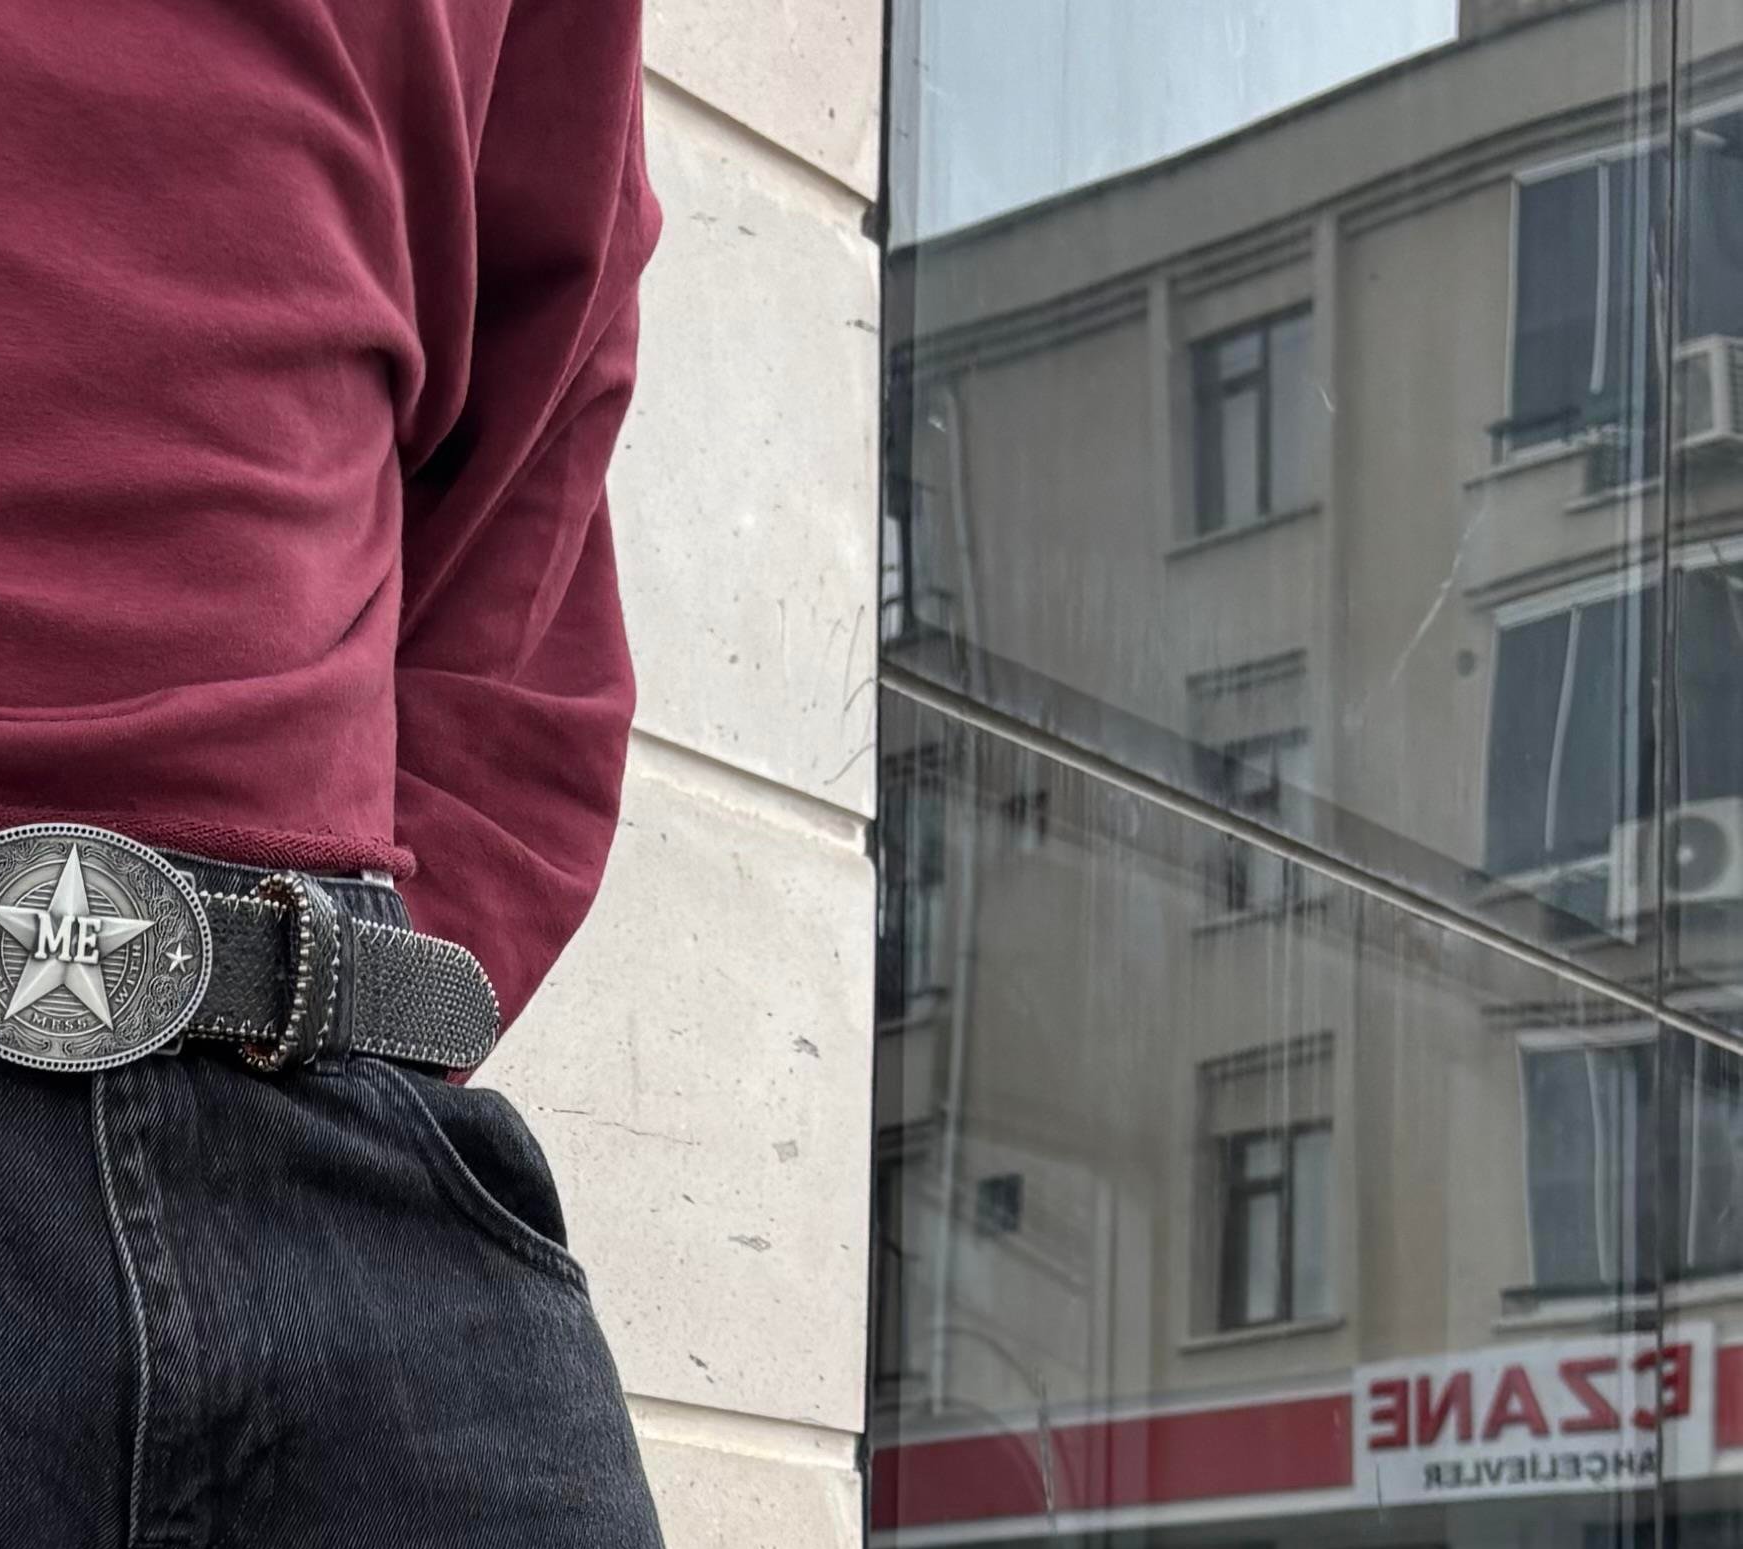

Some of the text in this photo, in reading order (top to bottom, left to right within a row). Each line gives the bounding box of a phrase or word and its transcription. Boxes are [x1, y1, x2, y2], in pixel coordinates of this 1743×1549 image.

[34, 912, 101, 964] ME
[31, 1013, 88, 1031] MESS
[115, 943, 142, 1005] WITH
